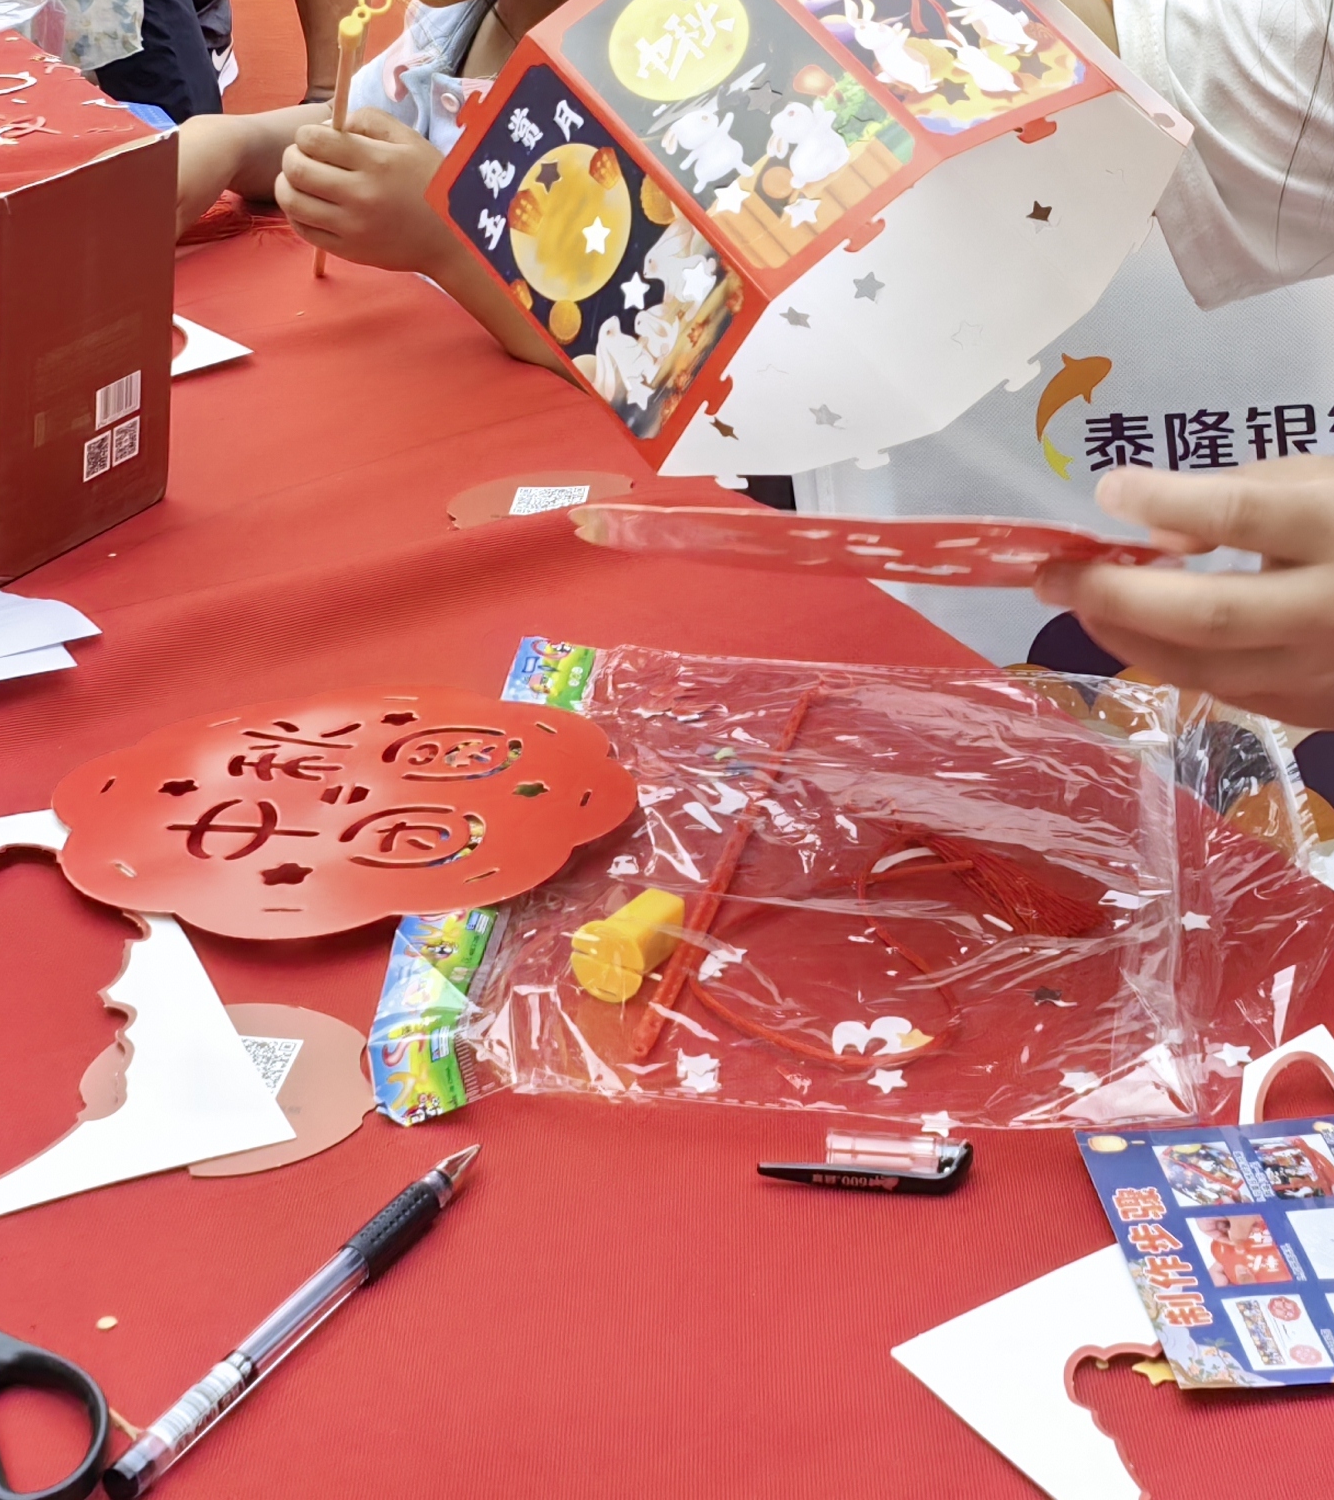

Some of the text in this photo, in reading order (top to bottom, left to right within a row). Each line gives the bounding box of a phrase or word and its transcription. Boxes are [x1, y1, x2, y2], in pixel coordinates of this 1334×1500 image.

[634, 0, 736, 82] 中秋
[477, 98, 586, 252] 玉兔赏月
[166, 720, 361, 861] 中秋
[1110, 1185, 1214, 1329] 制作步骤
